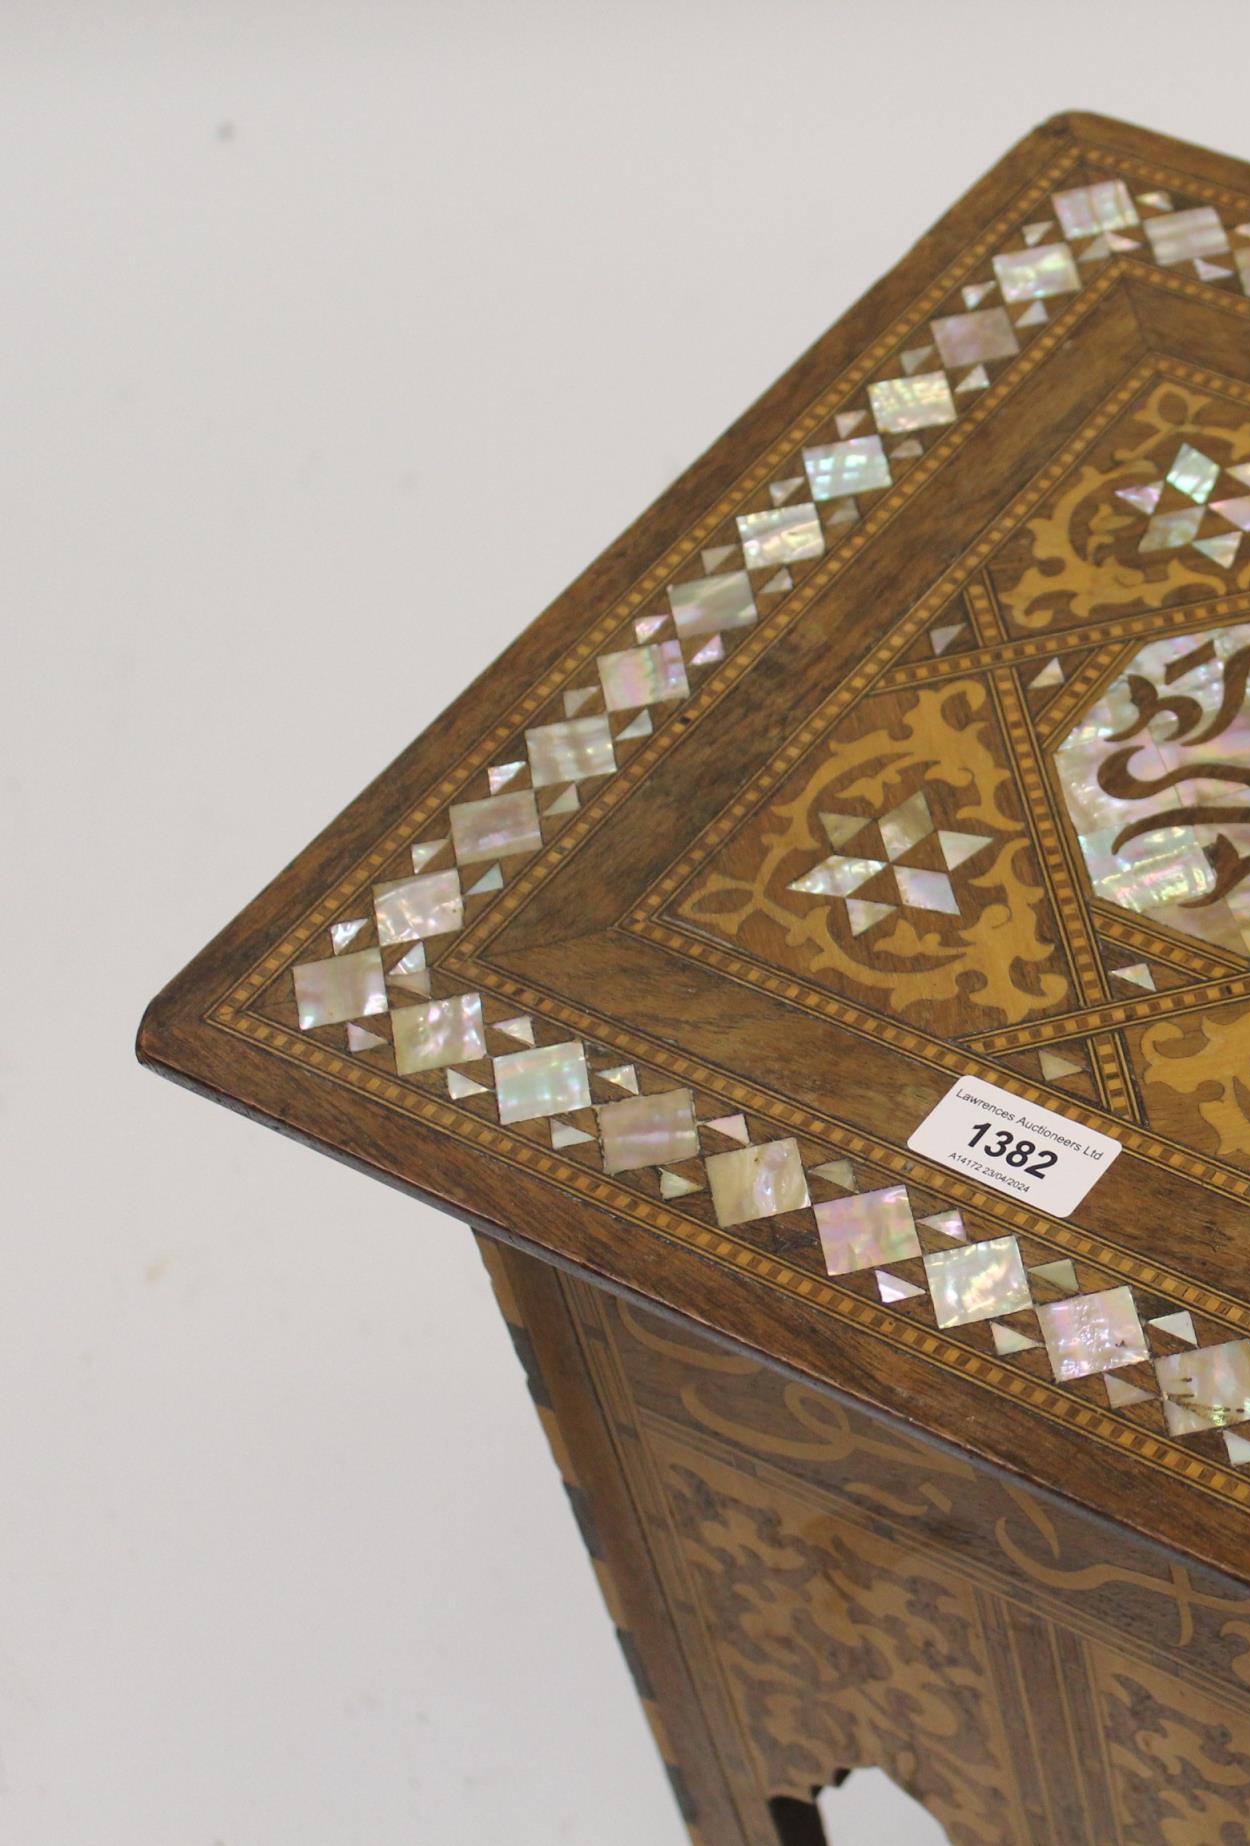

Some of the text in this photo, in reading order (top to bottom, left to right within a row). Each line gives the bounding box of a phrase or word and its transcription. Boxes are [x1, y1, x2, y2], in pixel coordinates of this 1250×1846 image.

[956, 1088, 1104, 1161] Lawrences Auctioneers Ltd
[967, 1122, 1058, 1180] 1382
[948, 1152, 1031, 1193] A14172 23/04/2024
